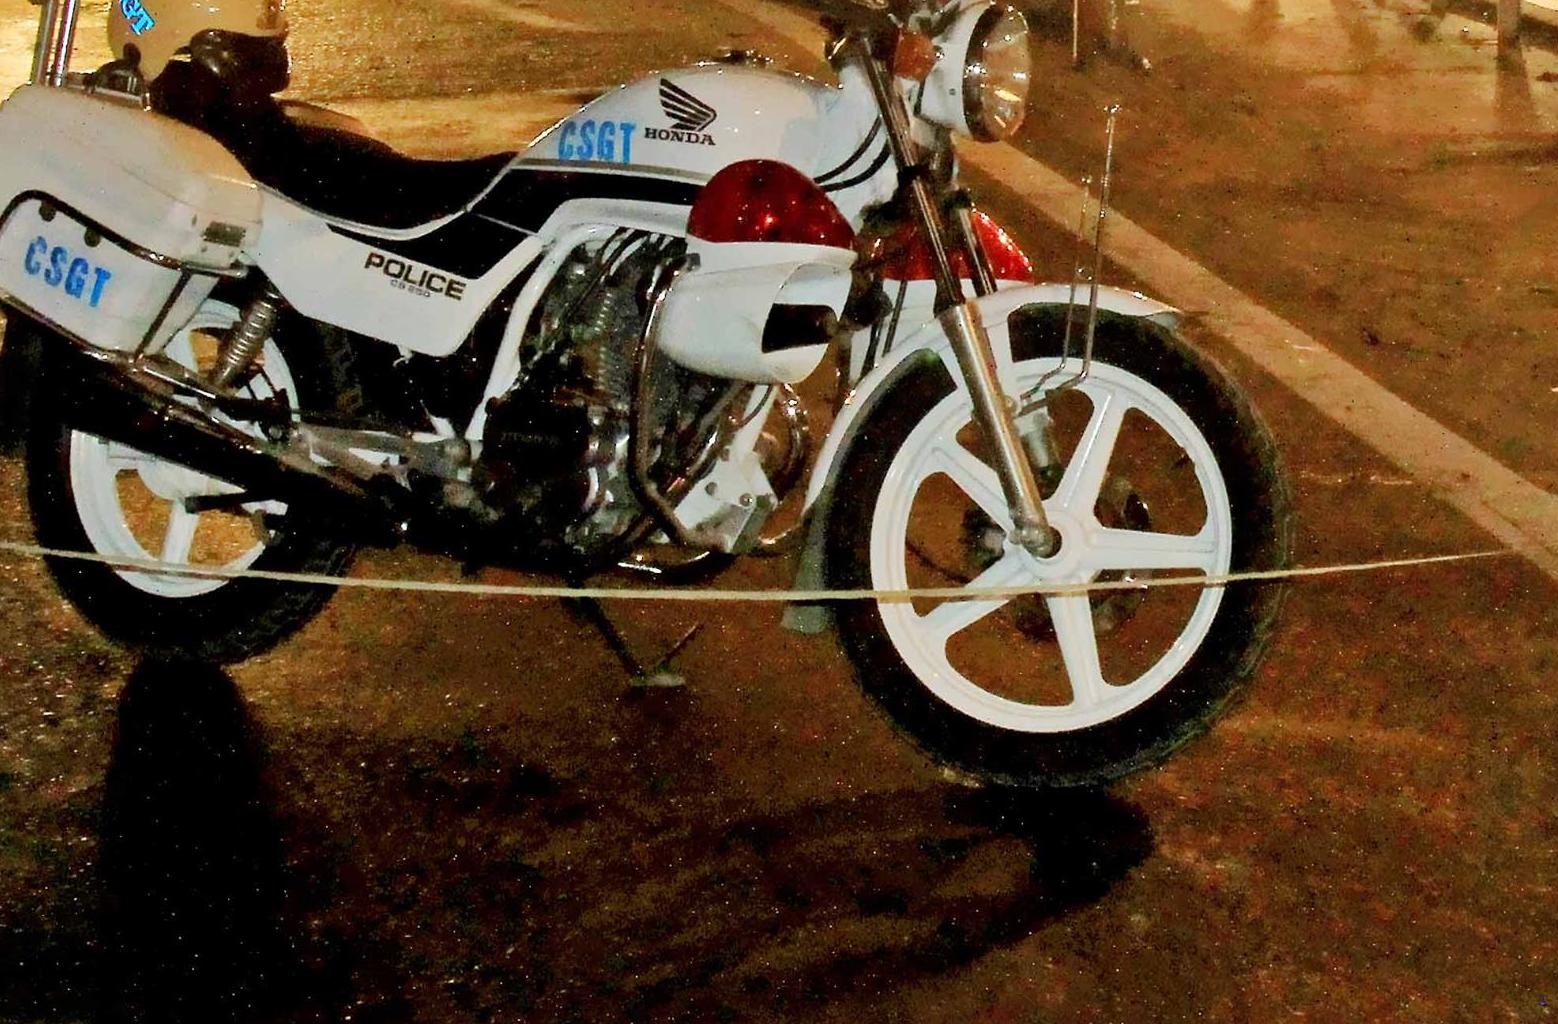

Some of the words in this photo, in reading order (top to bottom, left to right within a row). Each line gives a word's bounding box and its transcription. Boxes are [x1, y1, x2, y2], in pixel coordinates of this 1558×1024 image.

[558, 119, 636, 164] CSGT
[644, 127, 716, 146] HONDA
[25, 235, 112, 308] CSGT
[364, 251, 467, 301] POLICE
